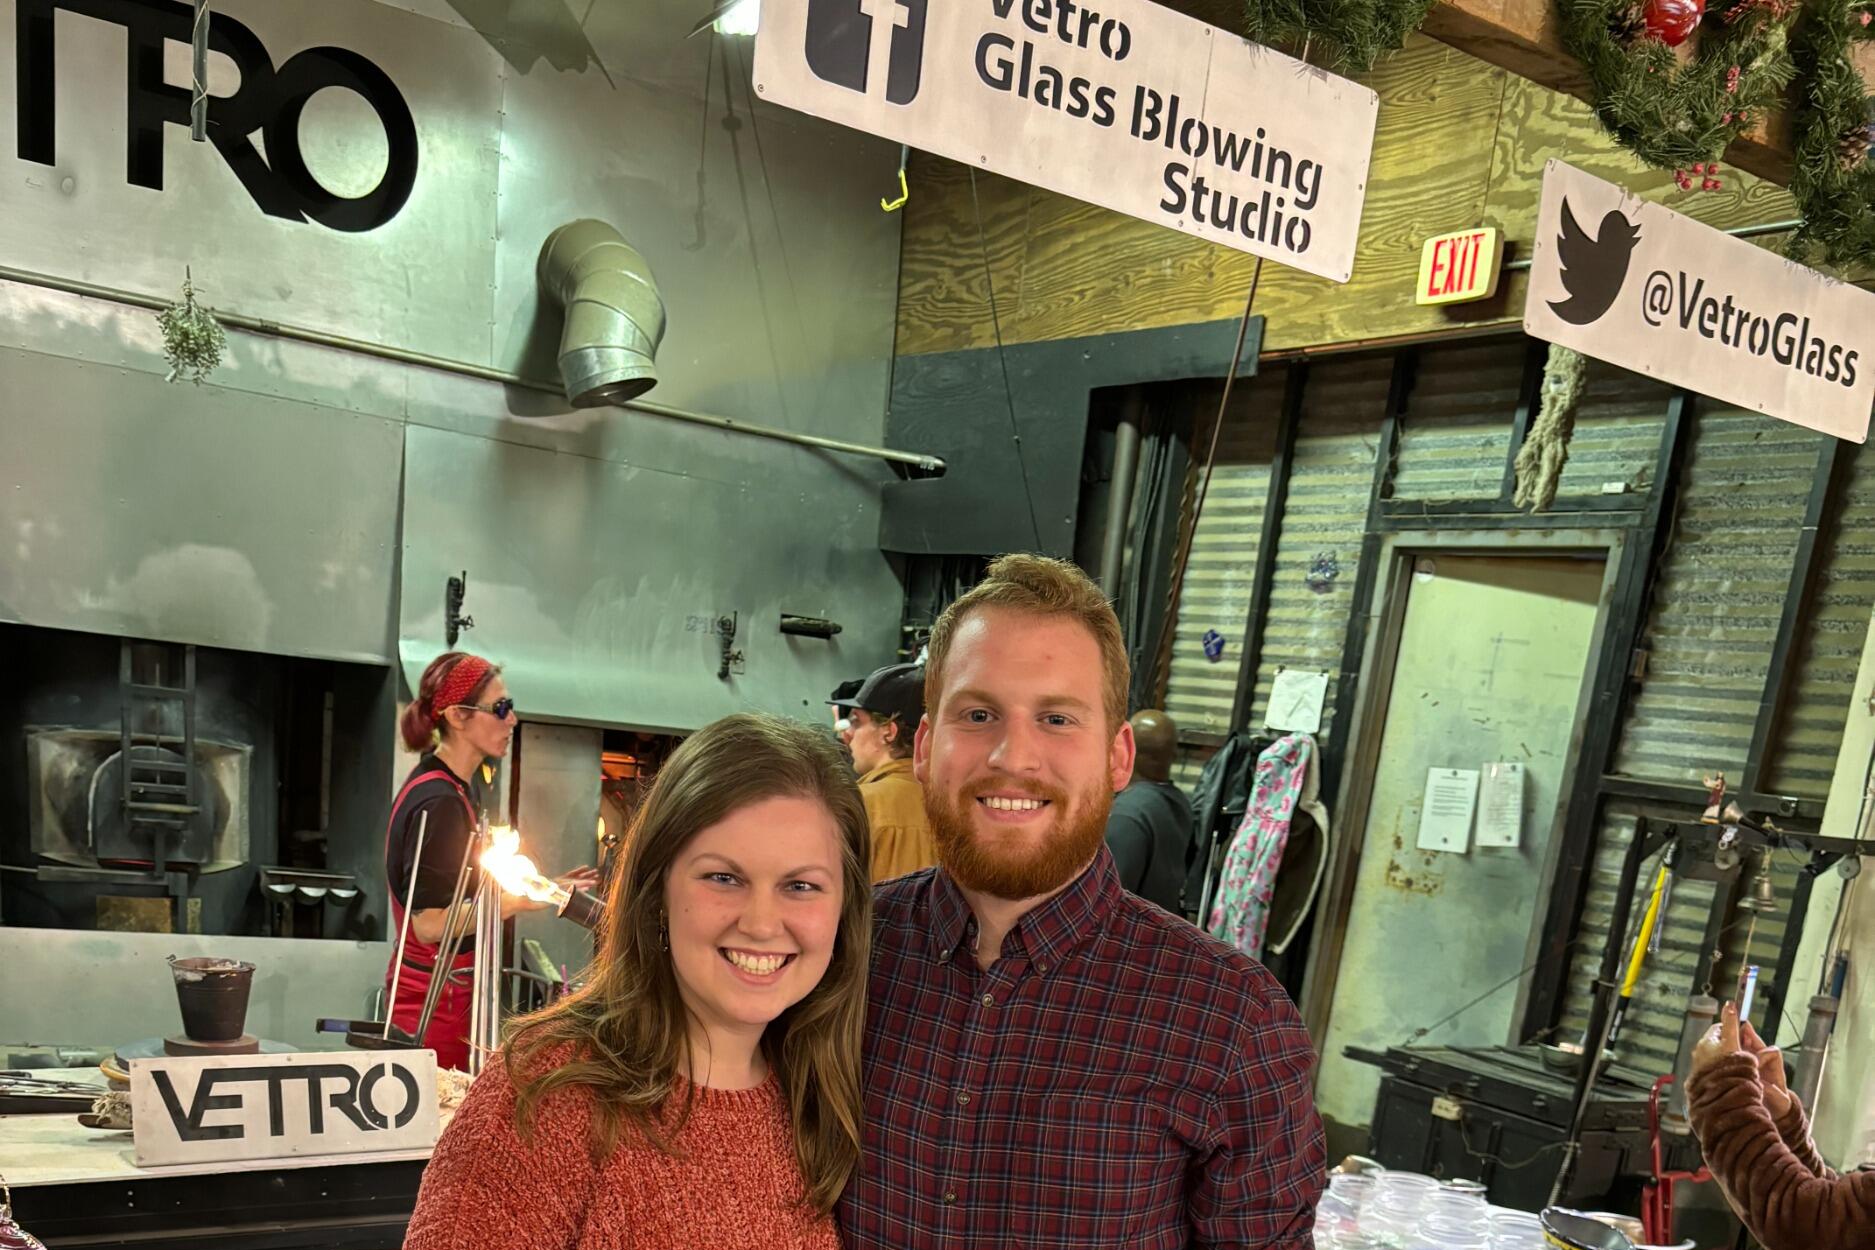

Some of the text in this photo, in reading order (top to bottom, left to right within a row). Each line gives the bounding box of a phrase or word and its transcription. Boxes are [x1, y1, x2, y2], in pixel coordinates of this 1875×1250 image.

[975, 32, 1323, 211] Glass Blowing
[1160, 162, 1312, 254] Studio
[1427, 233, 1485, 297] EXIT
[1642, 270, 1859, 387] @VetroGlass
[150, 1062, 420, 1142] VETRO
